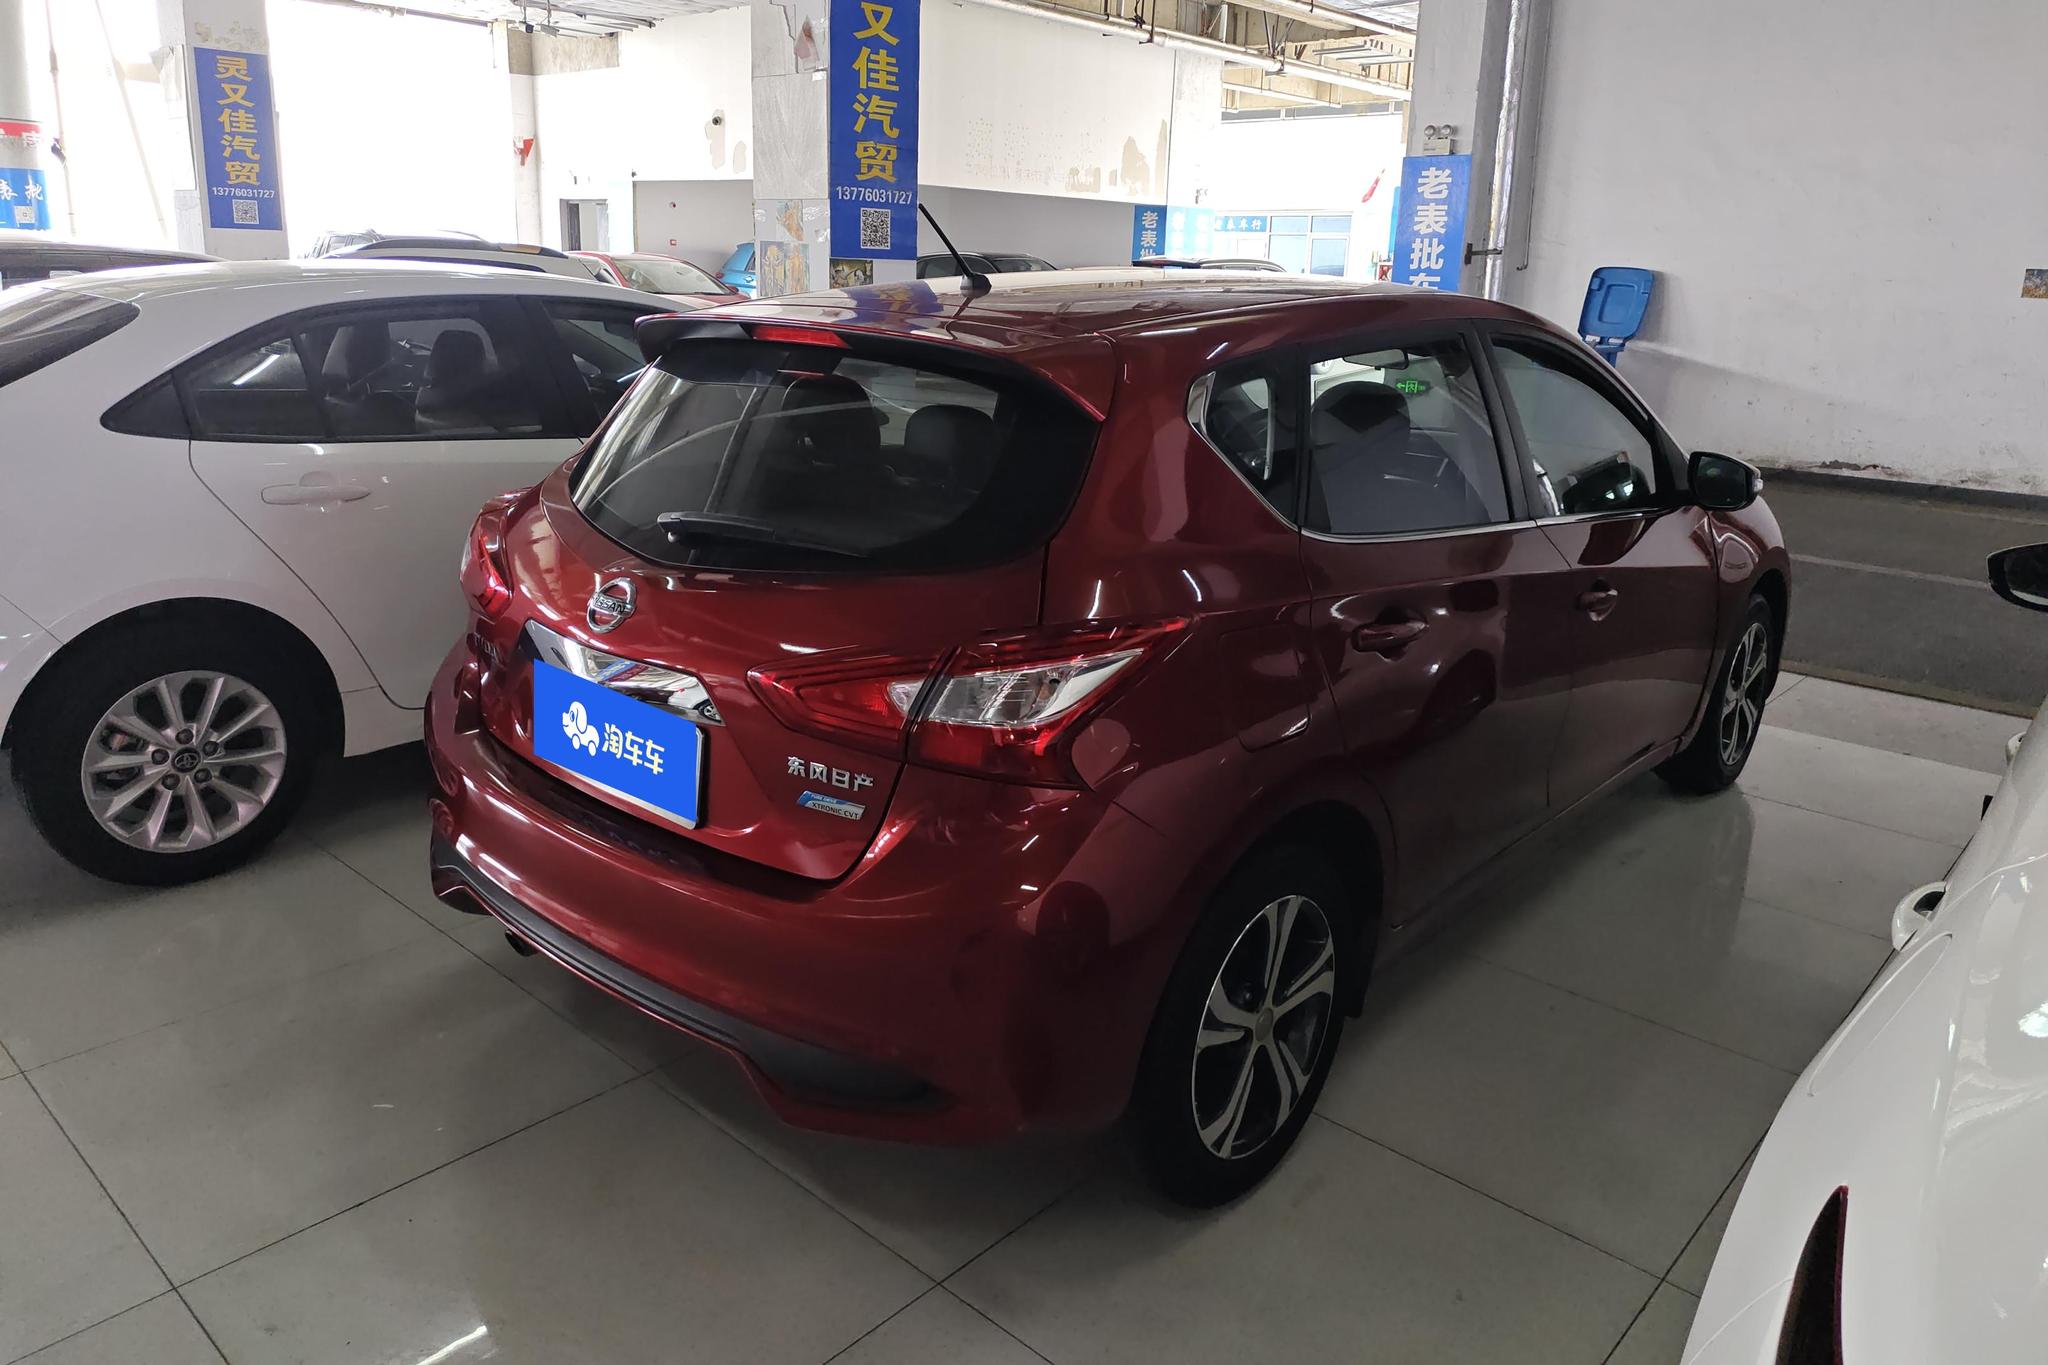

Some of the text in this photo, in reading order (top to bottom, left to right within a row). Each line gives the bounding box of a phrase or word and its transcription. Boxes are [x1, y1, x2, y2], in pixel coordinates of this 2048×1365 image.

[852, 1, 900, 182] 又佳汽贸
[215, 55, 261, 185] 灵又佳汽贸
[212, 187, 275, 198] 13776031727
[836, 186, 913, 205] 13776031727
[787, 756, 874, 792] 东风日产
[812, 802, 859, 819] XTRONIC CVT
